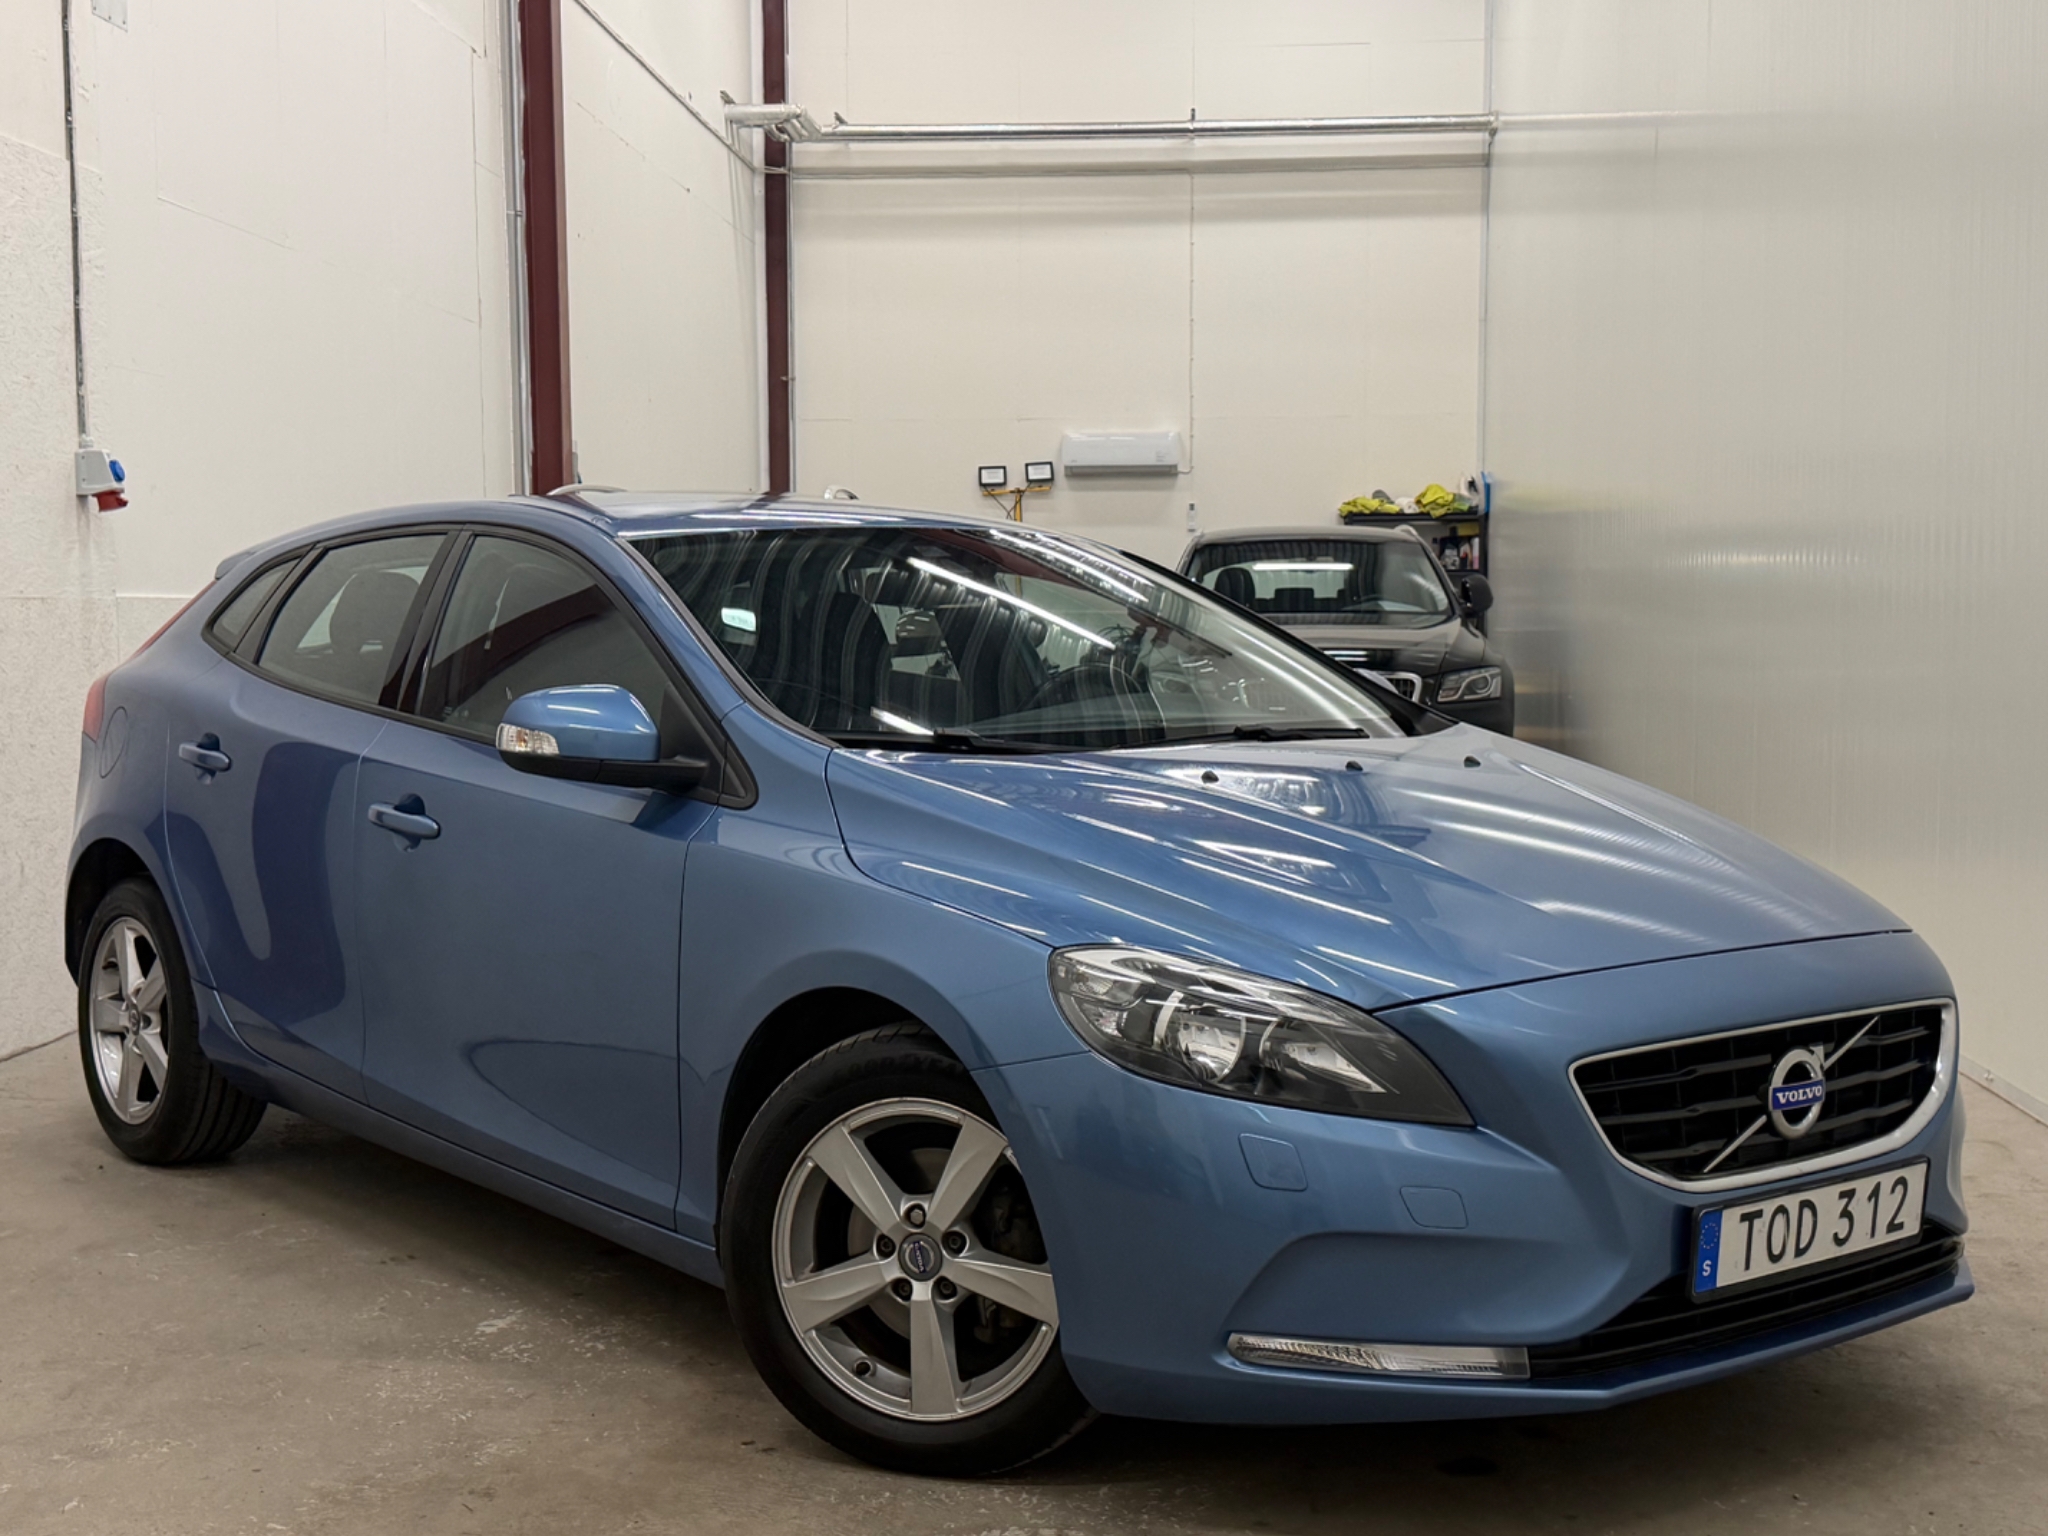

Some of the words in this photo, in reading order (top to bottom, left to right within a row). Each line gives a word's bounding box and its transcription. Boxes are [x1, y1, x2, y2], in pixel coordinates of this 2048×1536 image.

[1776, 1085, 1822, 1104] VOLVO
[1739, 1200, 1818, 1271] TOD
[1832, 1175, 1909, 1247] 312
[1702, 1259, 1712, 1276] S
